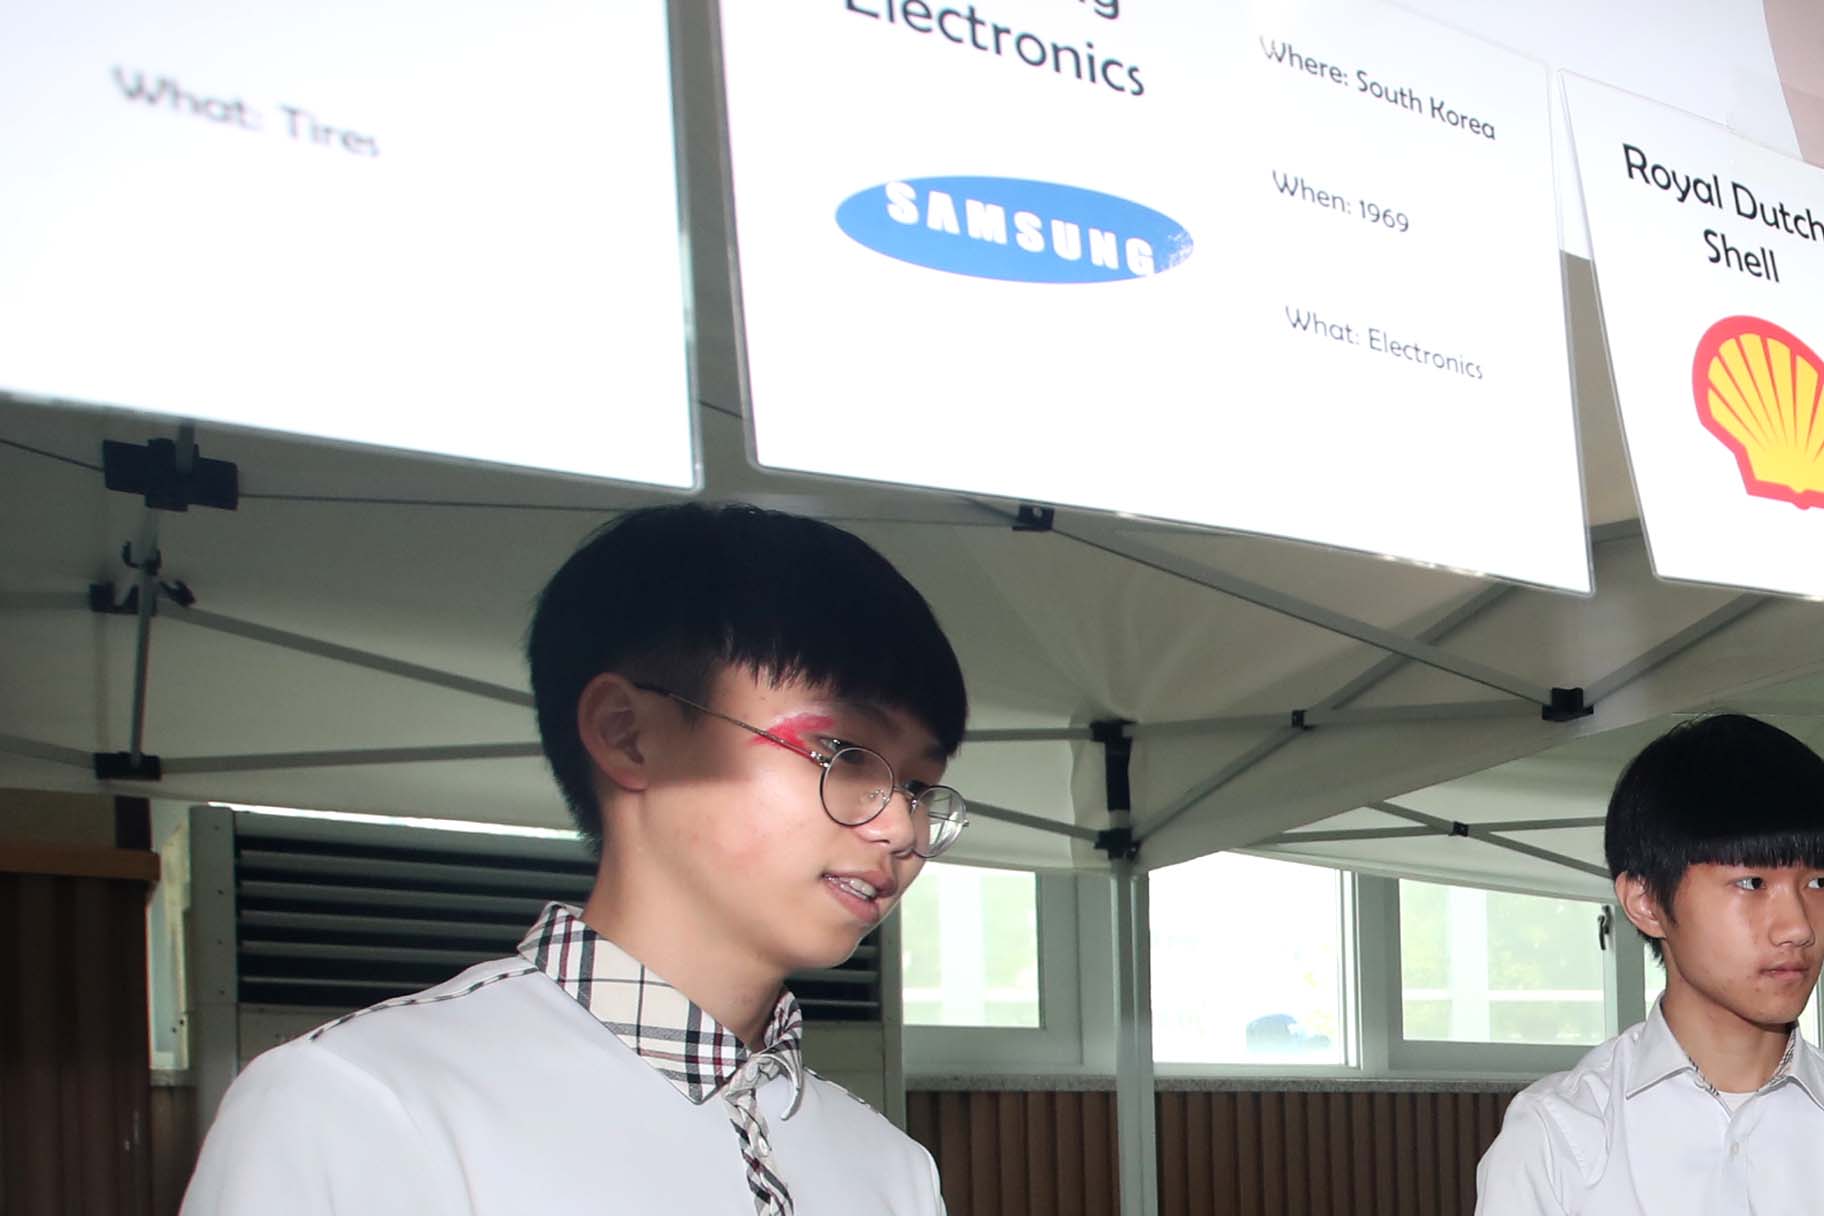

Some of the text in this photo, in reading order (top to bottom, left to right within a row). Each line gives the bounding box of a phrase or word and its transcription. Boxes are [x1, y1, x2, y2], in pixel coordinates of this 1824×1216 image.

[845, 0, 1146, 97] ectronics
[1258, 33, 1497, 142] Where: South Korea
[112, 64, 382, 159] What: Tires
[1271, 168, 1411, 235] When: 1969
[1622, 142, 1723, 210] Royal
[884, 179, 1157, 278] SAMSUNG
[1703, 228, 1781, 284] Shell
[1285, 304, 1485, 382] What: Electronics
